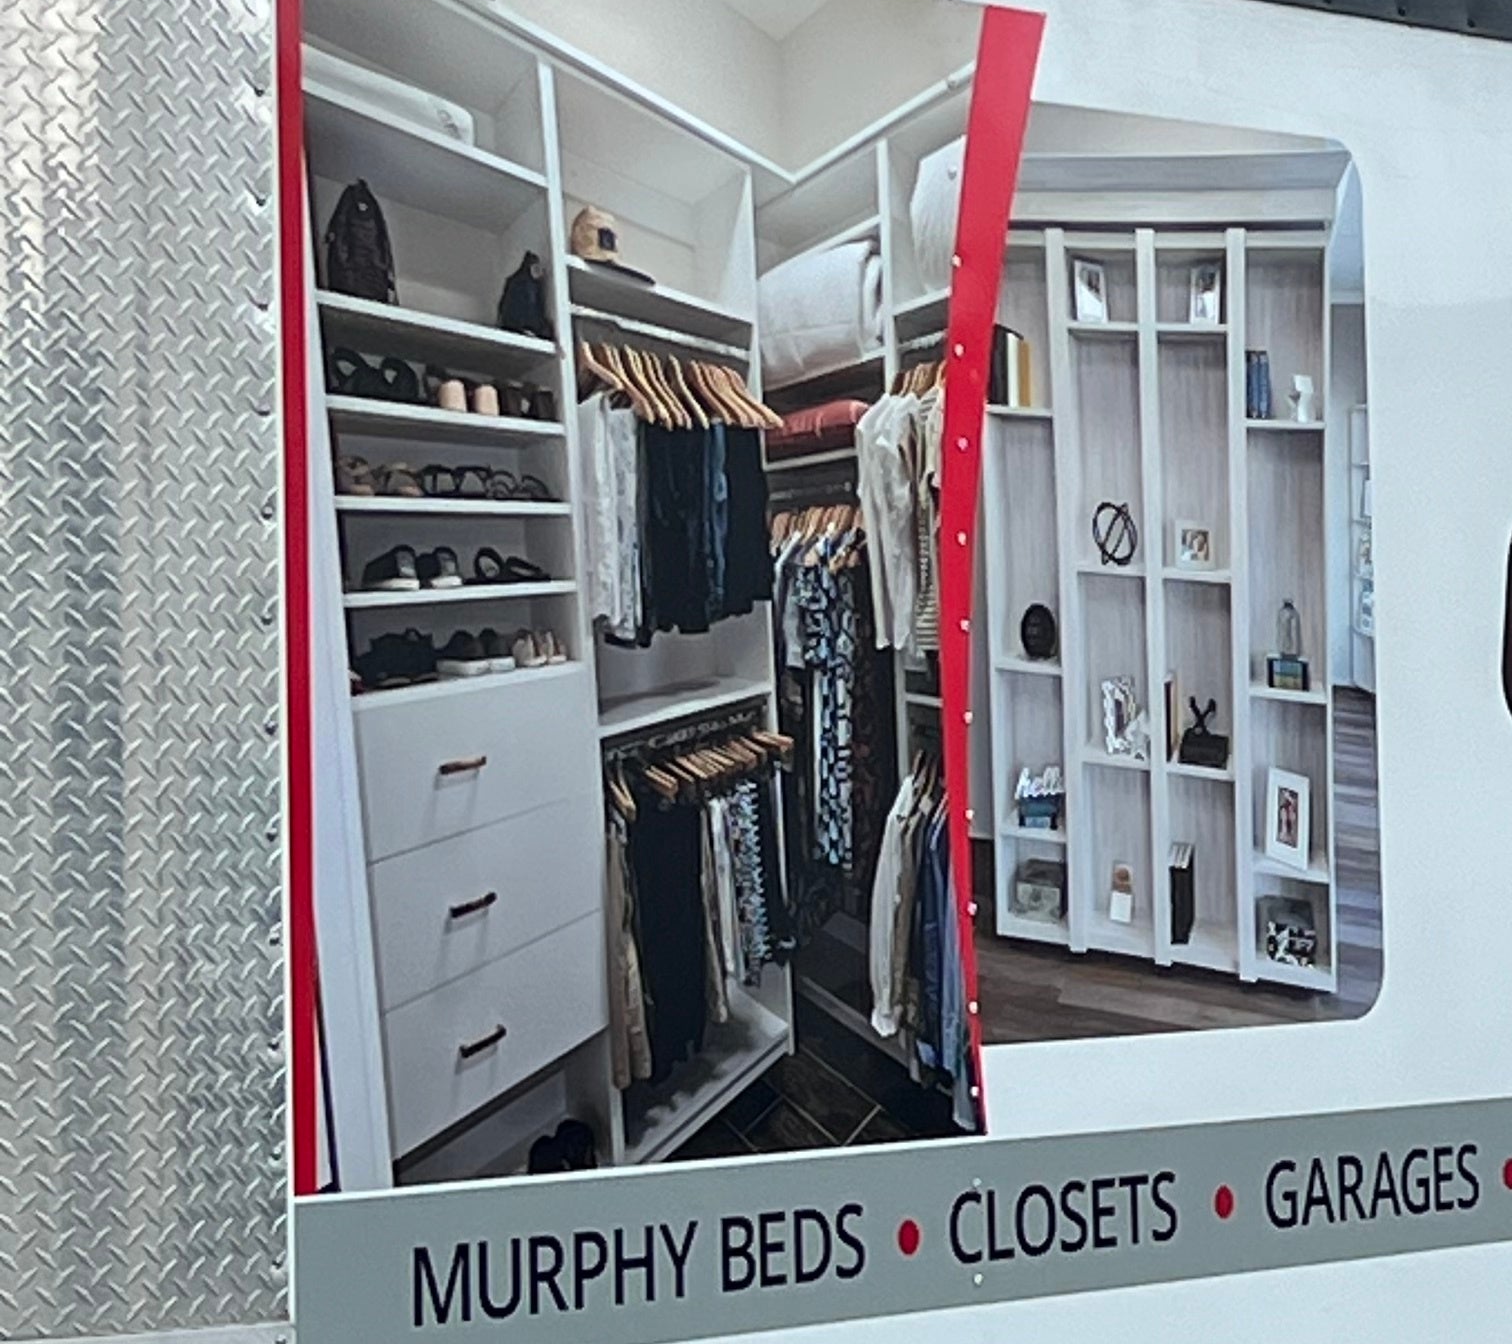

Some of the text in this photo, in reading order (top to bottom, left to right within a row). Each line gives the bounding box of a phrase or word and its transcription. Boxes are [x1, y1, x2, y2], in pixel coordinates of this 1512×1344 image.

[412, 1220, 700, 1328] MURPHY
[719, 1202, 866, 1293] BEDS
[948, 1170, 1179, 1266] CLOSETS
[1264, 1142, 1481, 1230] GARAGES
